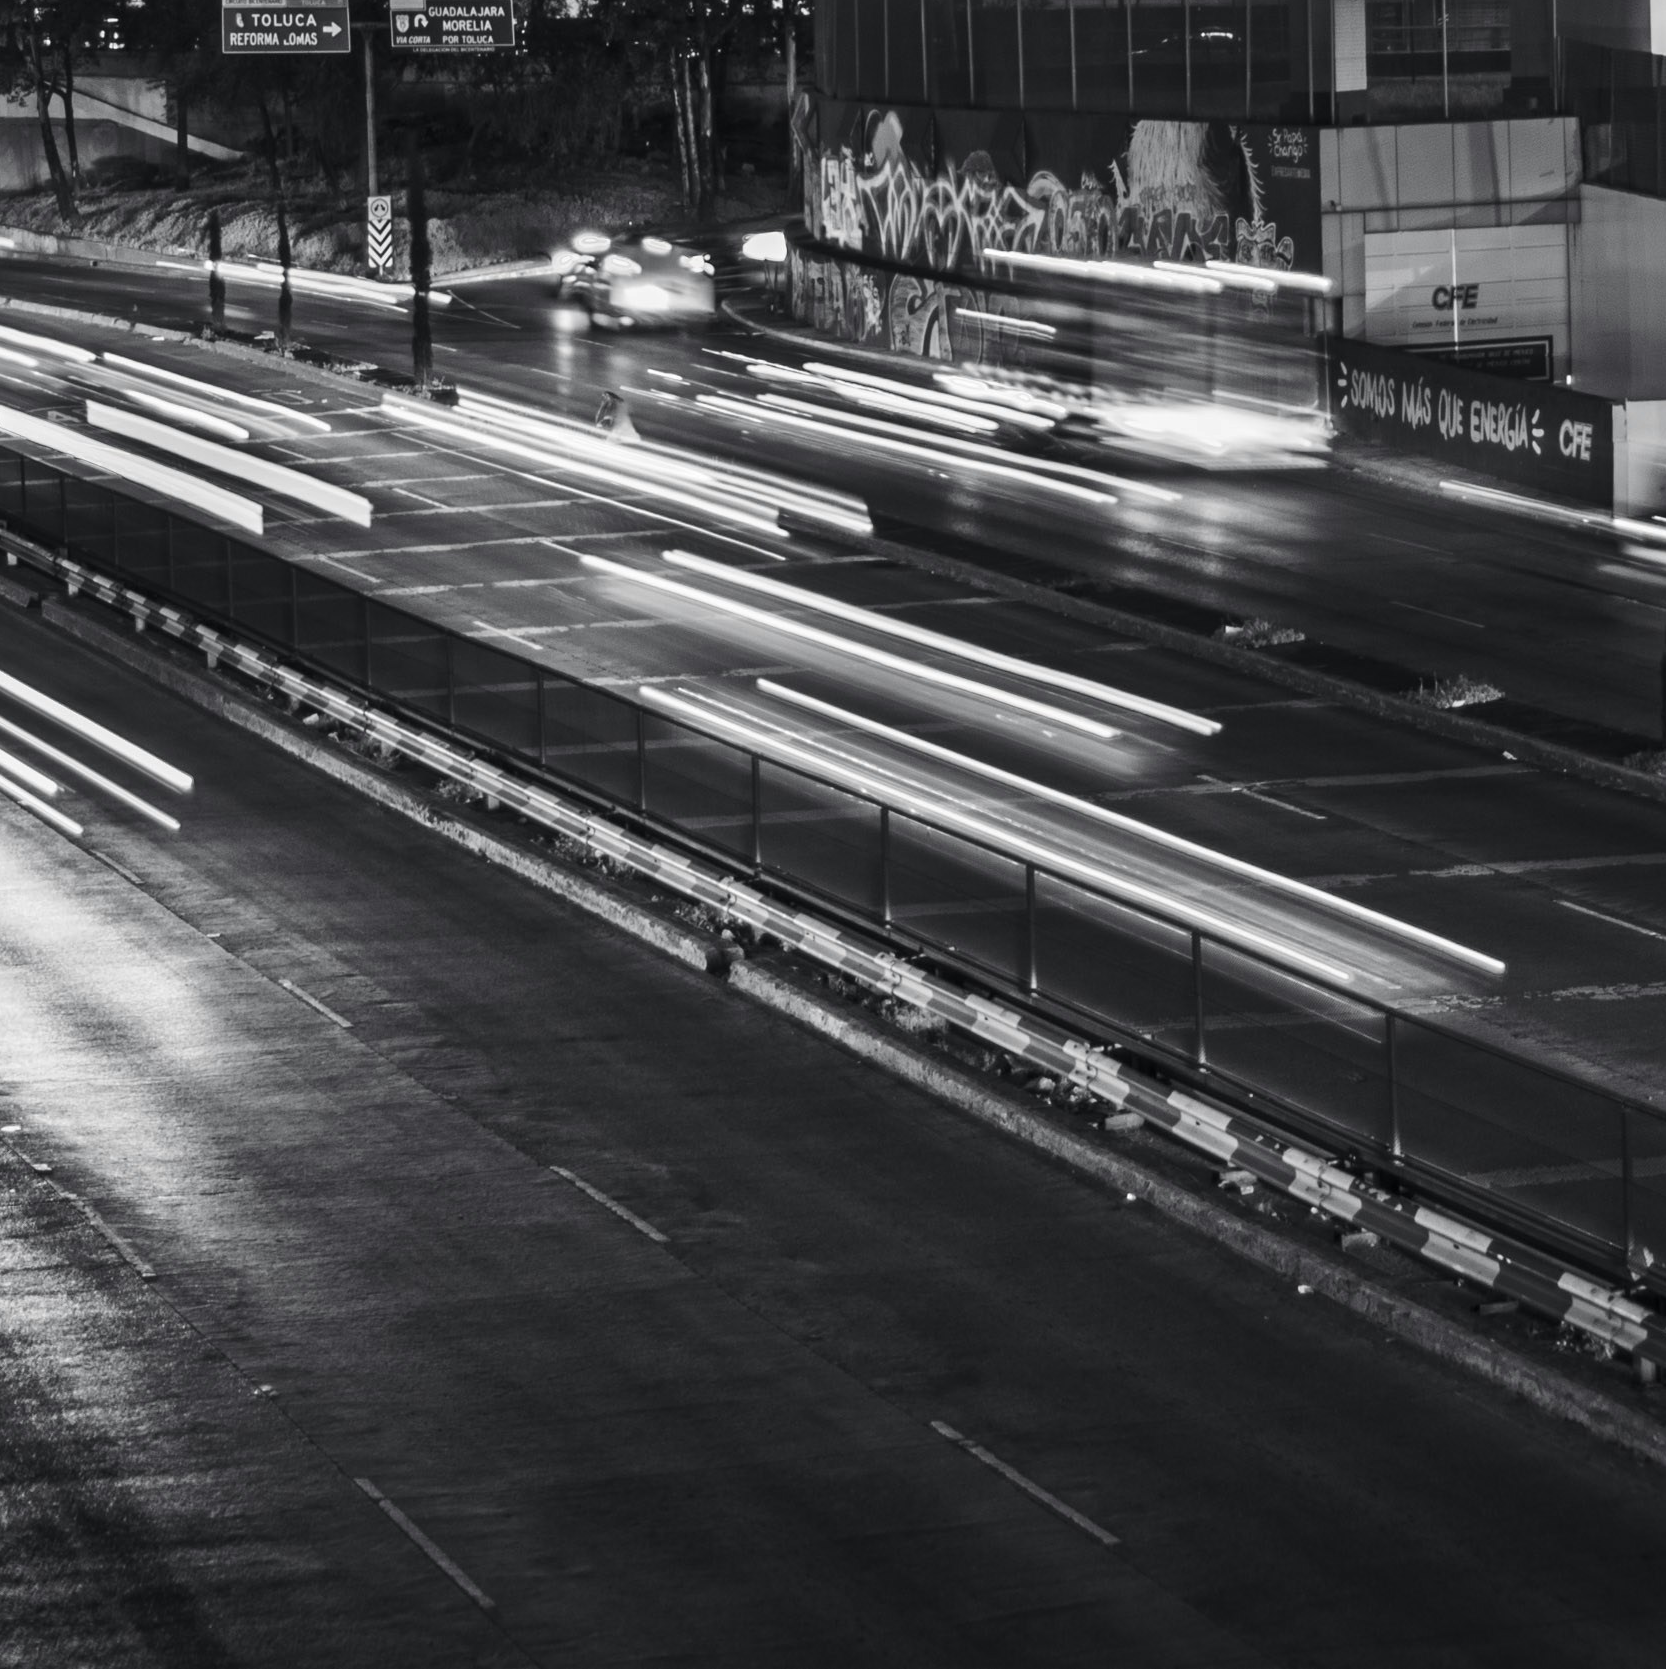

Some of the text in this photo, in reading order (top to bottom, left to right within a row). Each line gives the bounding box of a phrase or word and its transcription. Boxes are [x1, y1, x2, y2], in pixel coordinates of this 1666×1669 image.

[428, 6, 505, 17] GUADALAJARA
[251, 13, 317, 27] TOLUCA
[442, 20, 493, 32] MORELIA
[230, 32, 279, 46] REFORMA
[396, 36, 431, 44] VIA CORTA
[442, 35, 494, 44] POR TOLUCA
[1431, 282, 1480, 311] CFE
[1351, 369, 1529, 452] SOMOS MÁS QUE ENERGÍA
[1559, 419, 1593, 461] CFE
